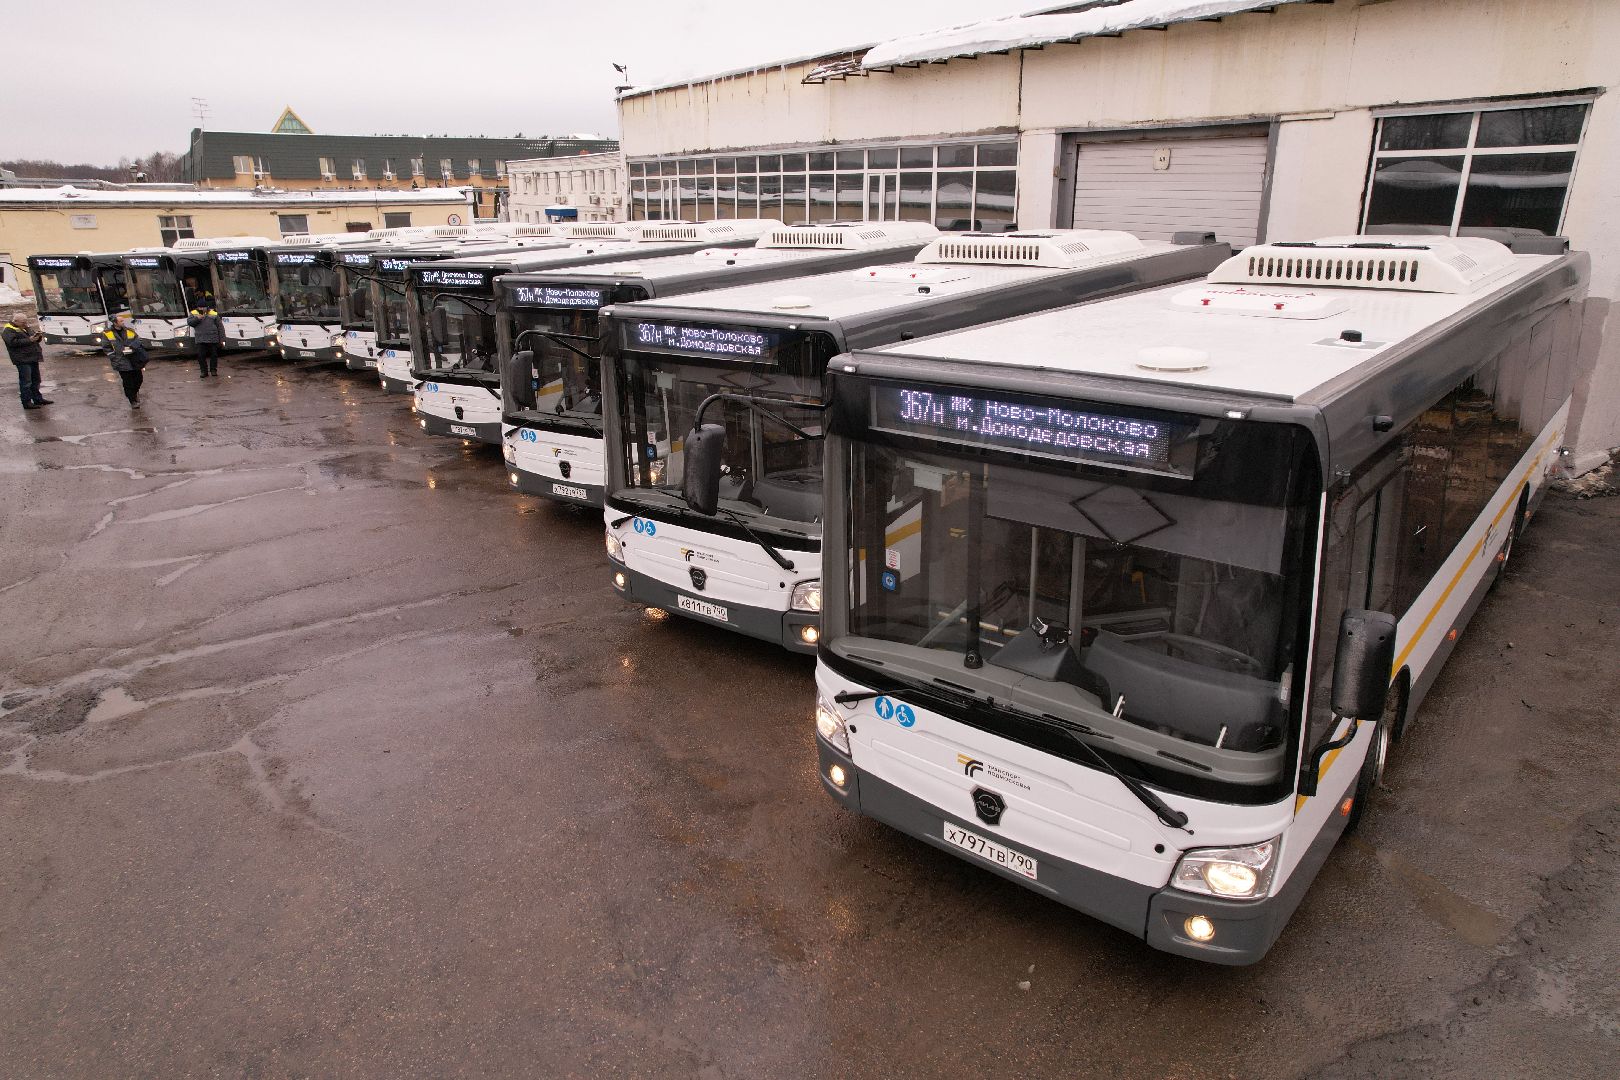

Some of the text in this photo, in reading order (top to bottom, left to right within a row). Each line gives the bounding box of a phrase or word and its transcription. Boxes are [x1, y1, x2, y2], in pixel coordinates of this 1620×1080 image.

[664, 325, 677, 336] ЖК
[681, 327, 764, 344] Ново-Молоково
[668, 336, 761, 356] м.Домодедовская
[951, 395, 974, 413] ЖК
[986, 400, 1158, 439] Ново-Молоково
[1009, 851, 1034, 871] 790
